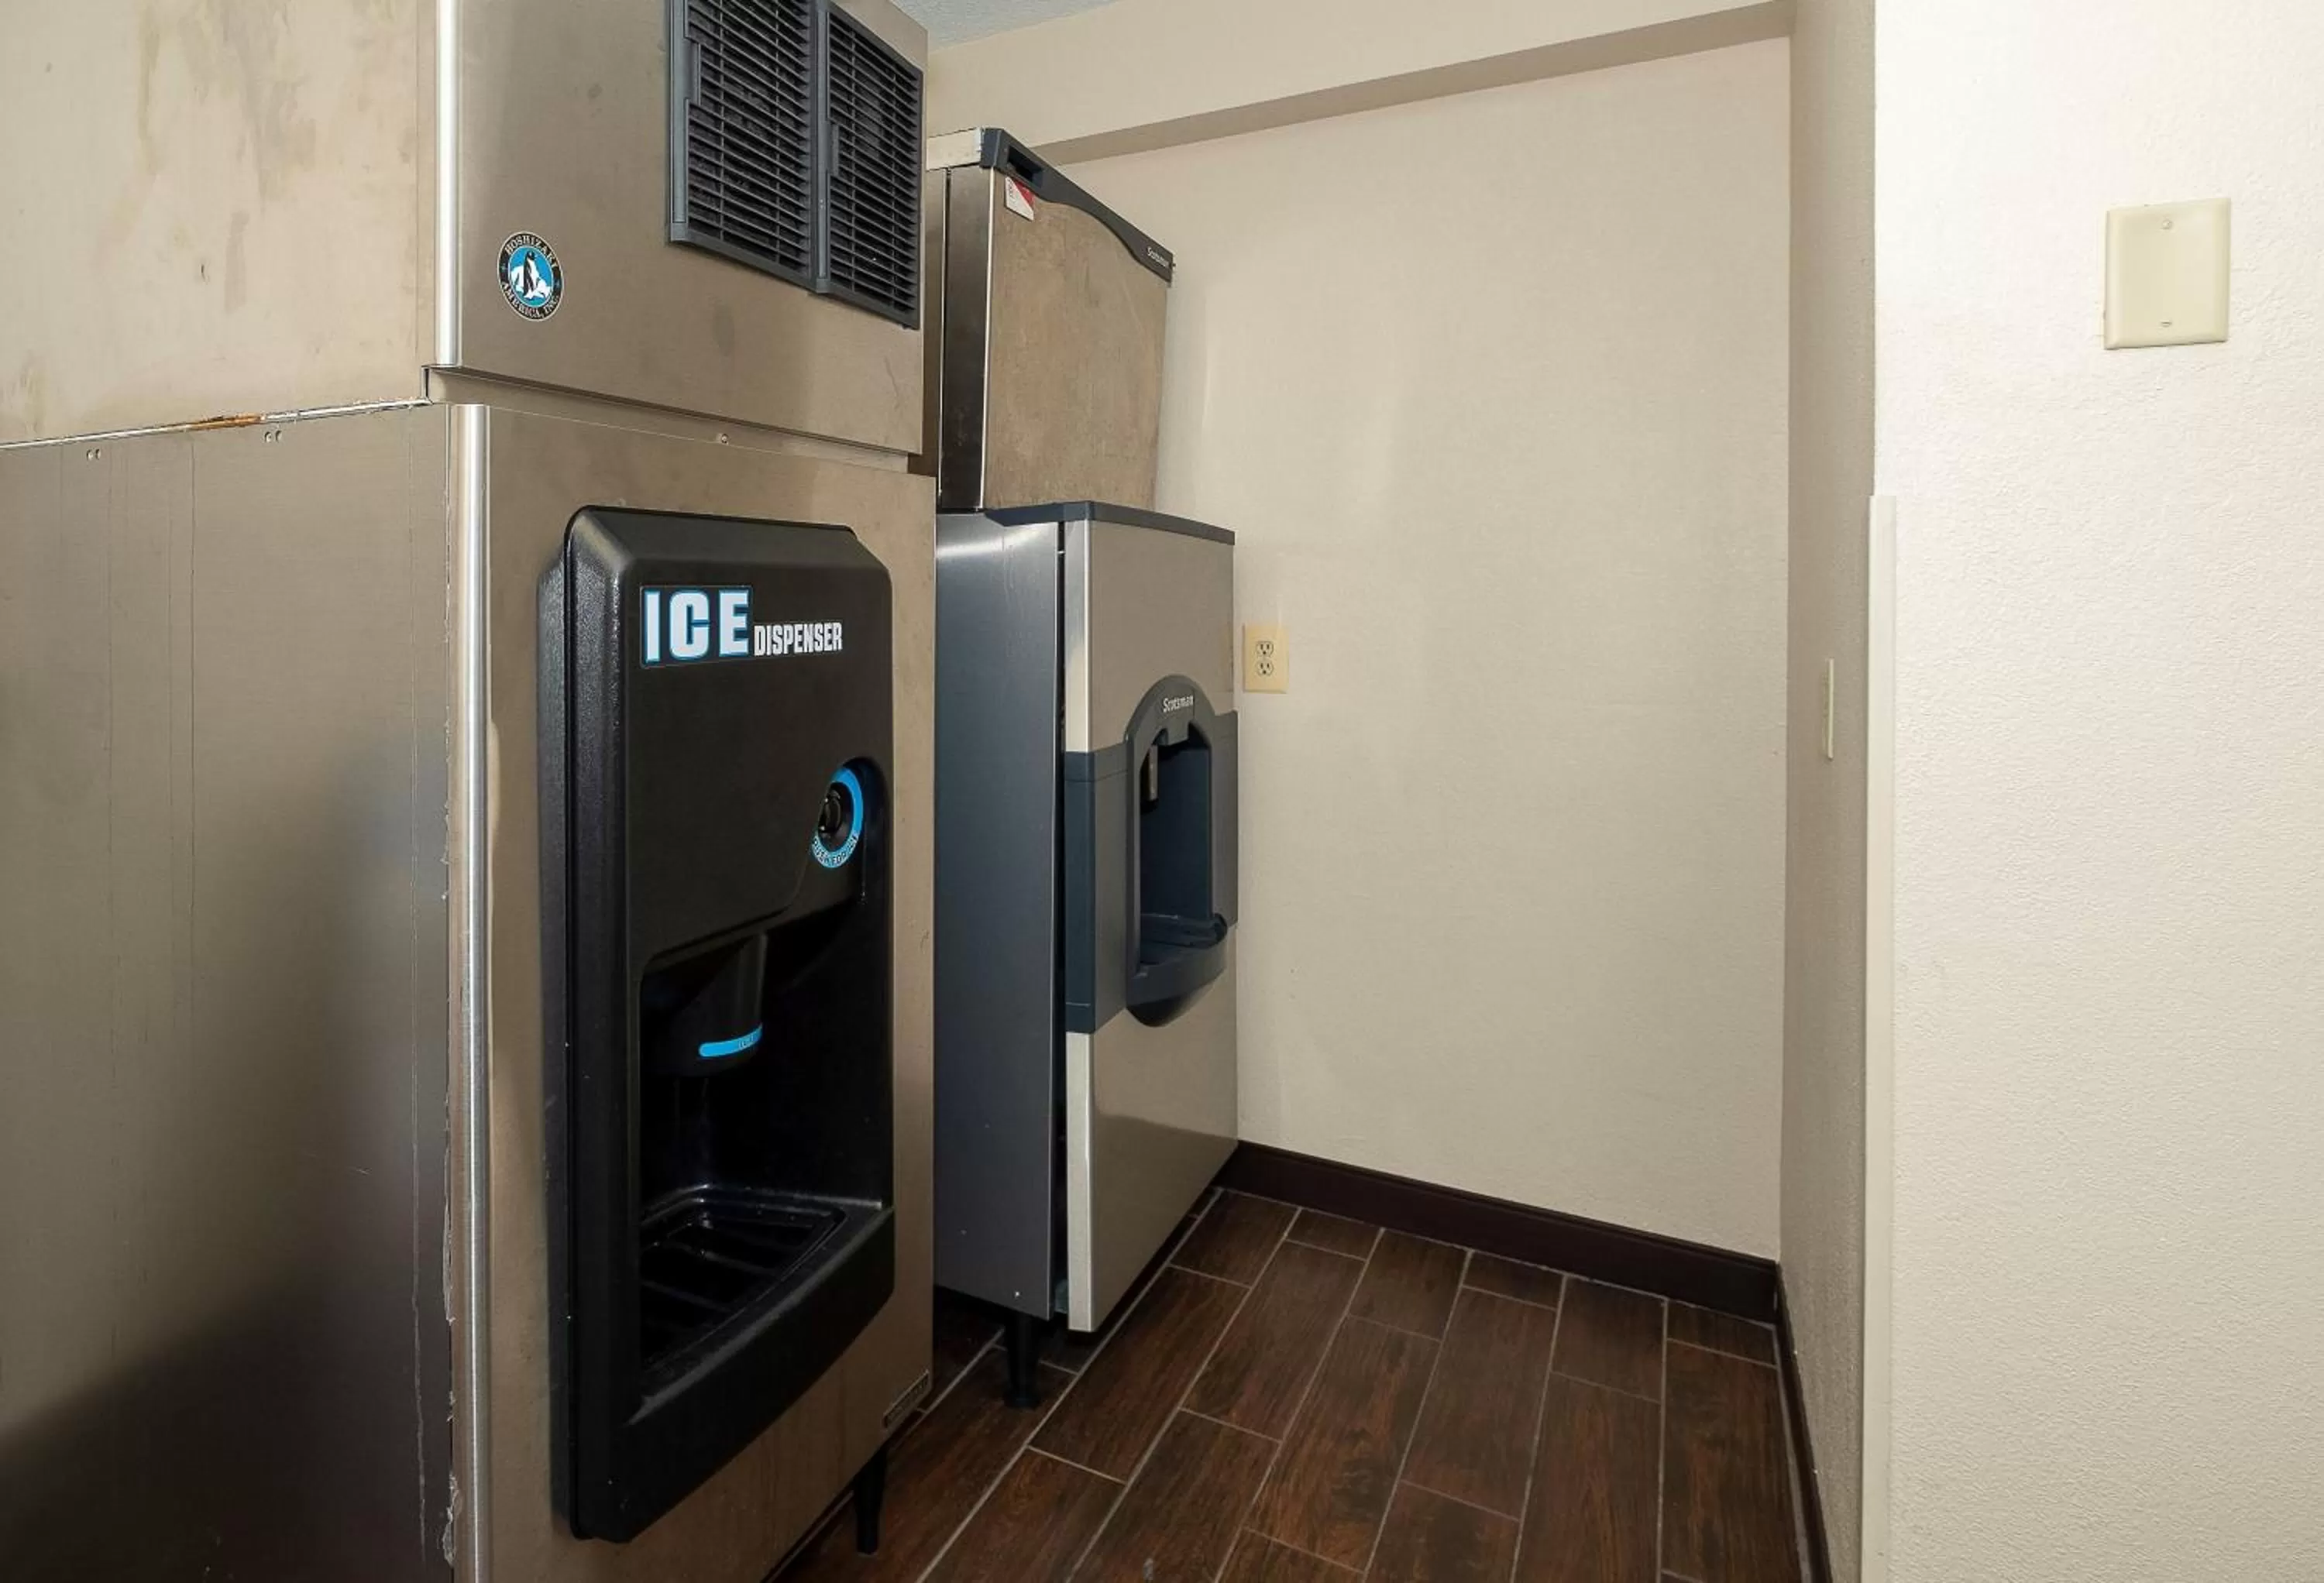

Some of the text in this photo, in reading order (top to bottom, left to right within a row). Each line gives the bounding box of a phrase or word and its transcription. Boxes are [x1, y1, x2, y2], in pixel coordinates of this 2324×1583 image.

[504, 235, 558, 268] HOSHIZAKI
[644, 589, 843, 663] ICE DISPENSER
